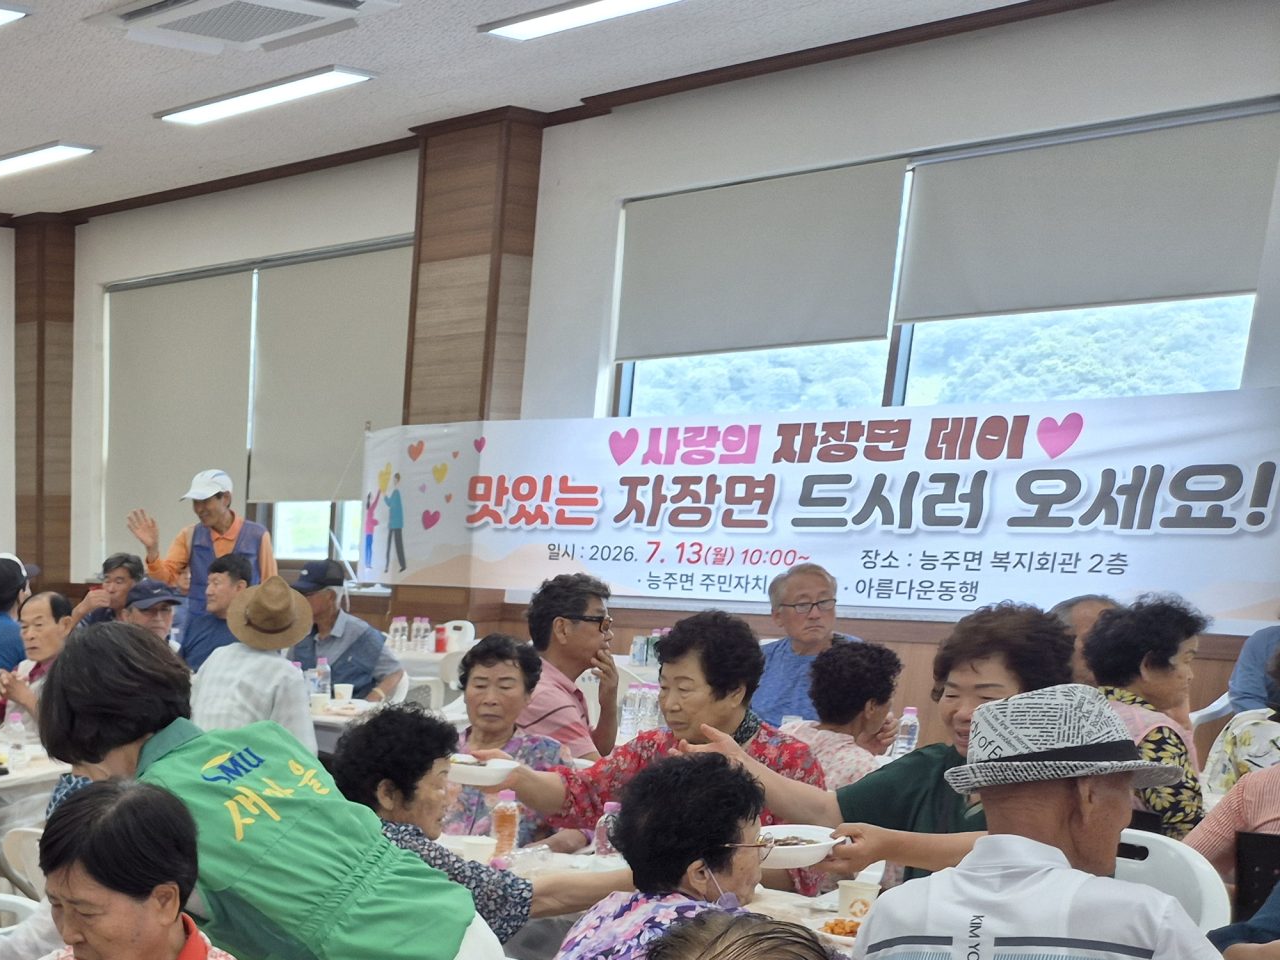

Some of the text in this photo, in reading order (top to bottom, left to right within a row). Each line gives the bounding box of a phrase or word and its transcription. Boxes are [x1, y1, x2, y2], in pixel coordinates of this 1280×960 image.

[641, 414, 1030, 465] 사랑의 자장면 데이
[465, 460, 1277, 531] 맛있는 자장면 드시러 오세요!
[547, 543, 575, 561] 일시
[588, 545, 638, 563] 2026.
[645, 541, 665, 564] 7.
[860, 549, 900, 570] 장소
[919, 550, 983, 572] 능주면
[989, 552, 1081, 574] 복지회관
[1087, 552, 1129, 575] 2층
[646, 571, 694, 592] 능주면
[855, 578, 980, 601] 아름다운동행
[978, 736, 995, 751] of
[223, 759, 331, 841] 새마을
[968, 915, 985, 939] KIM
